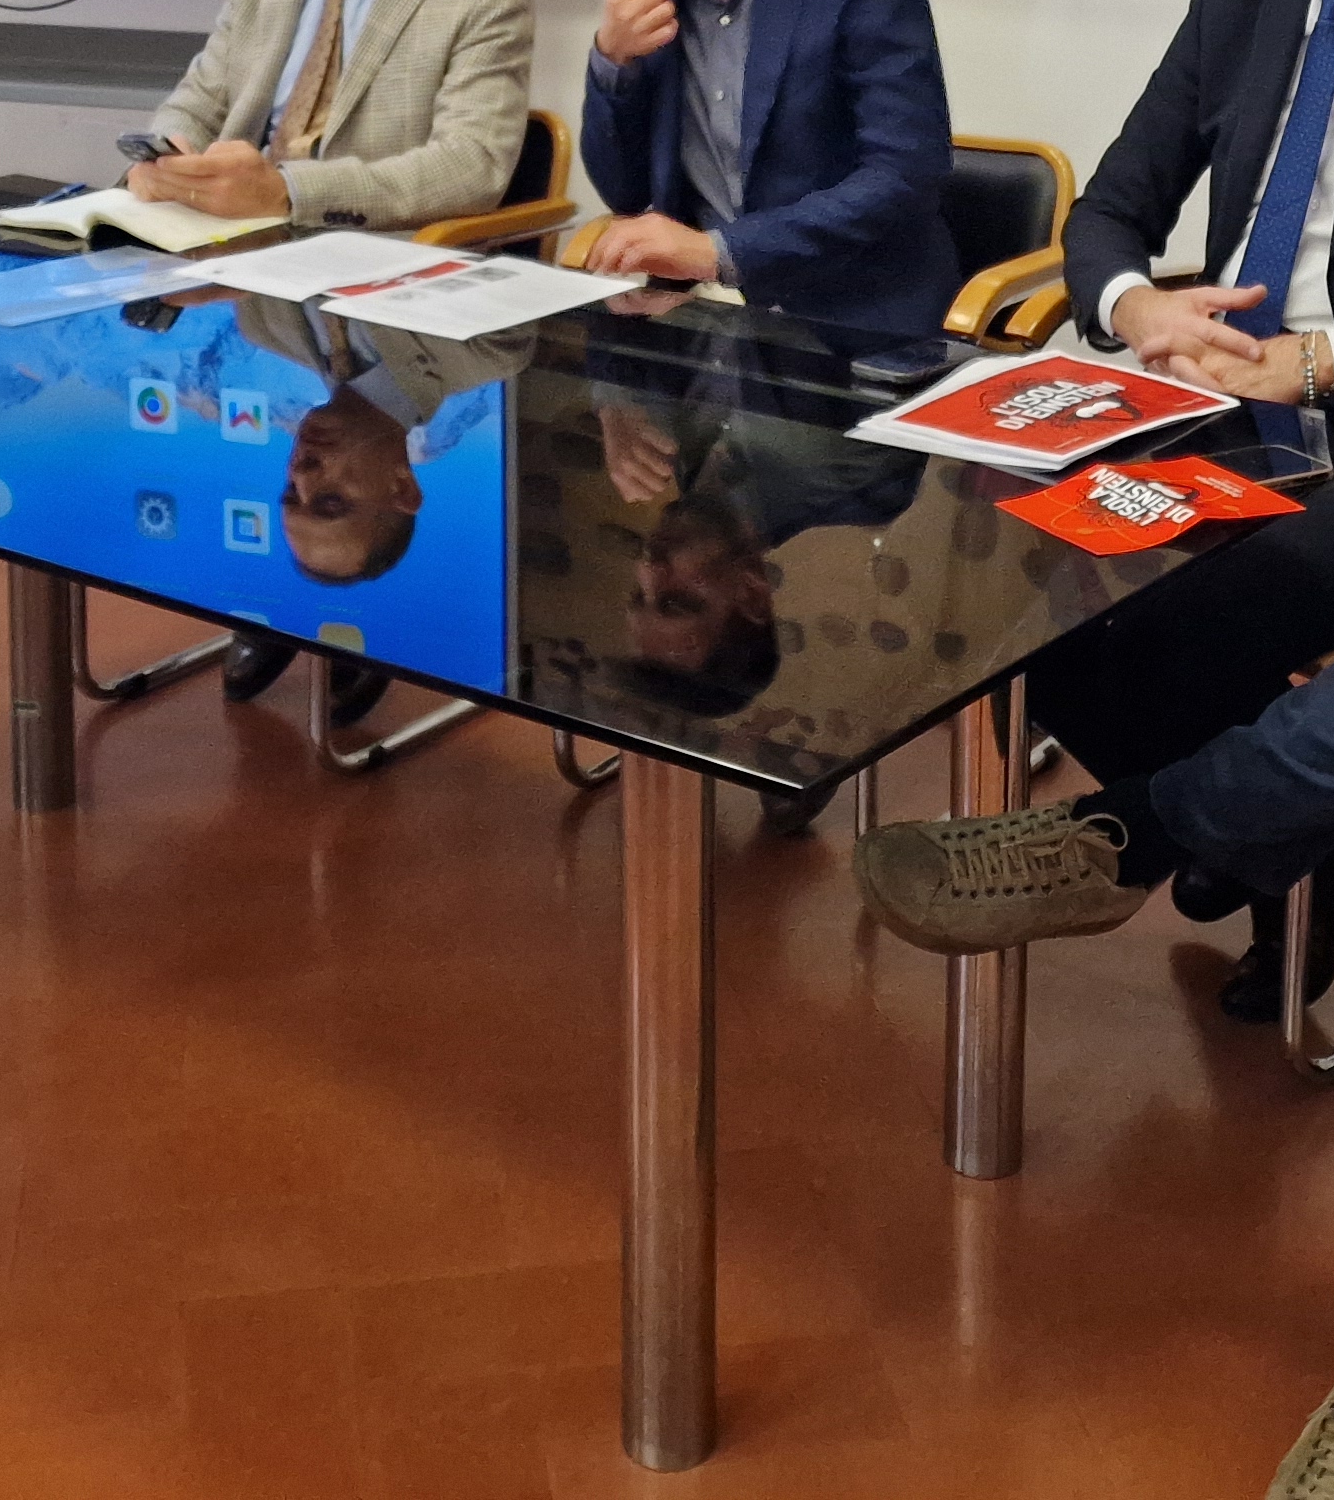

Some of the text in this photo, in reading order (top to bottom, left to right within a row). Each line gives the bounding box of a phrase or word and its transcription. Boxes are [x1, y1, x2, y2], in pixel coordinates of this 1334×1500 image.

[990, 380, 1083, 416] L'ISOLA
[994, 415, 1035, 431] DI
[1087, 467, 1175, 514] EINSTEIN
[1087, 485, 1160, 527] L'ISOLA
[1165, 504, 1197, 524] DI
